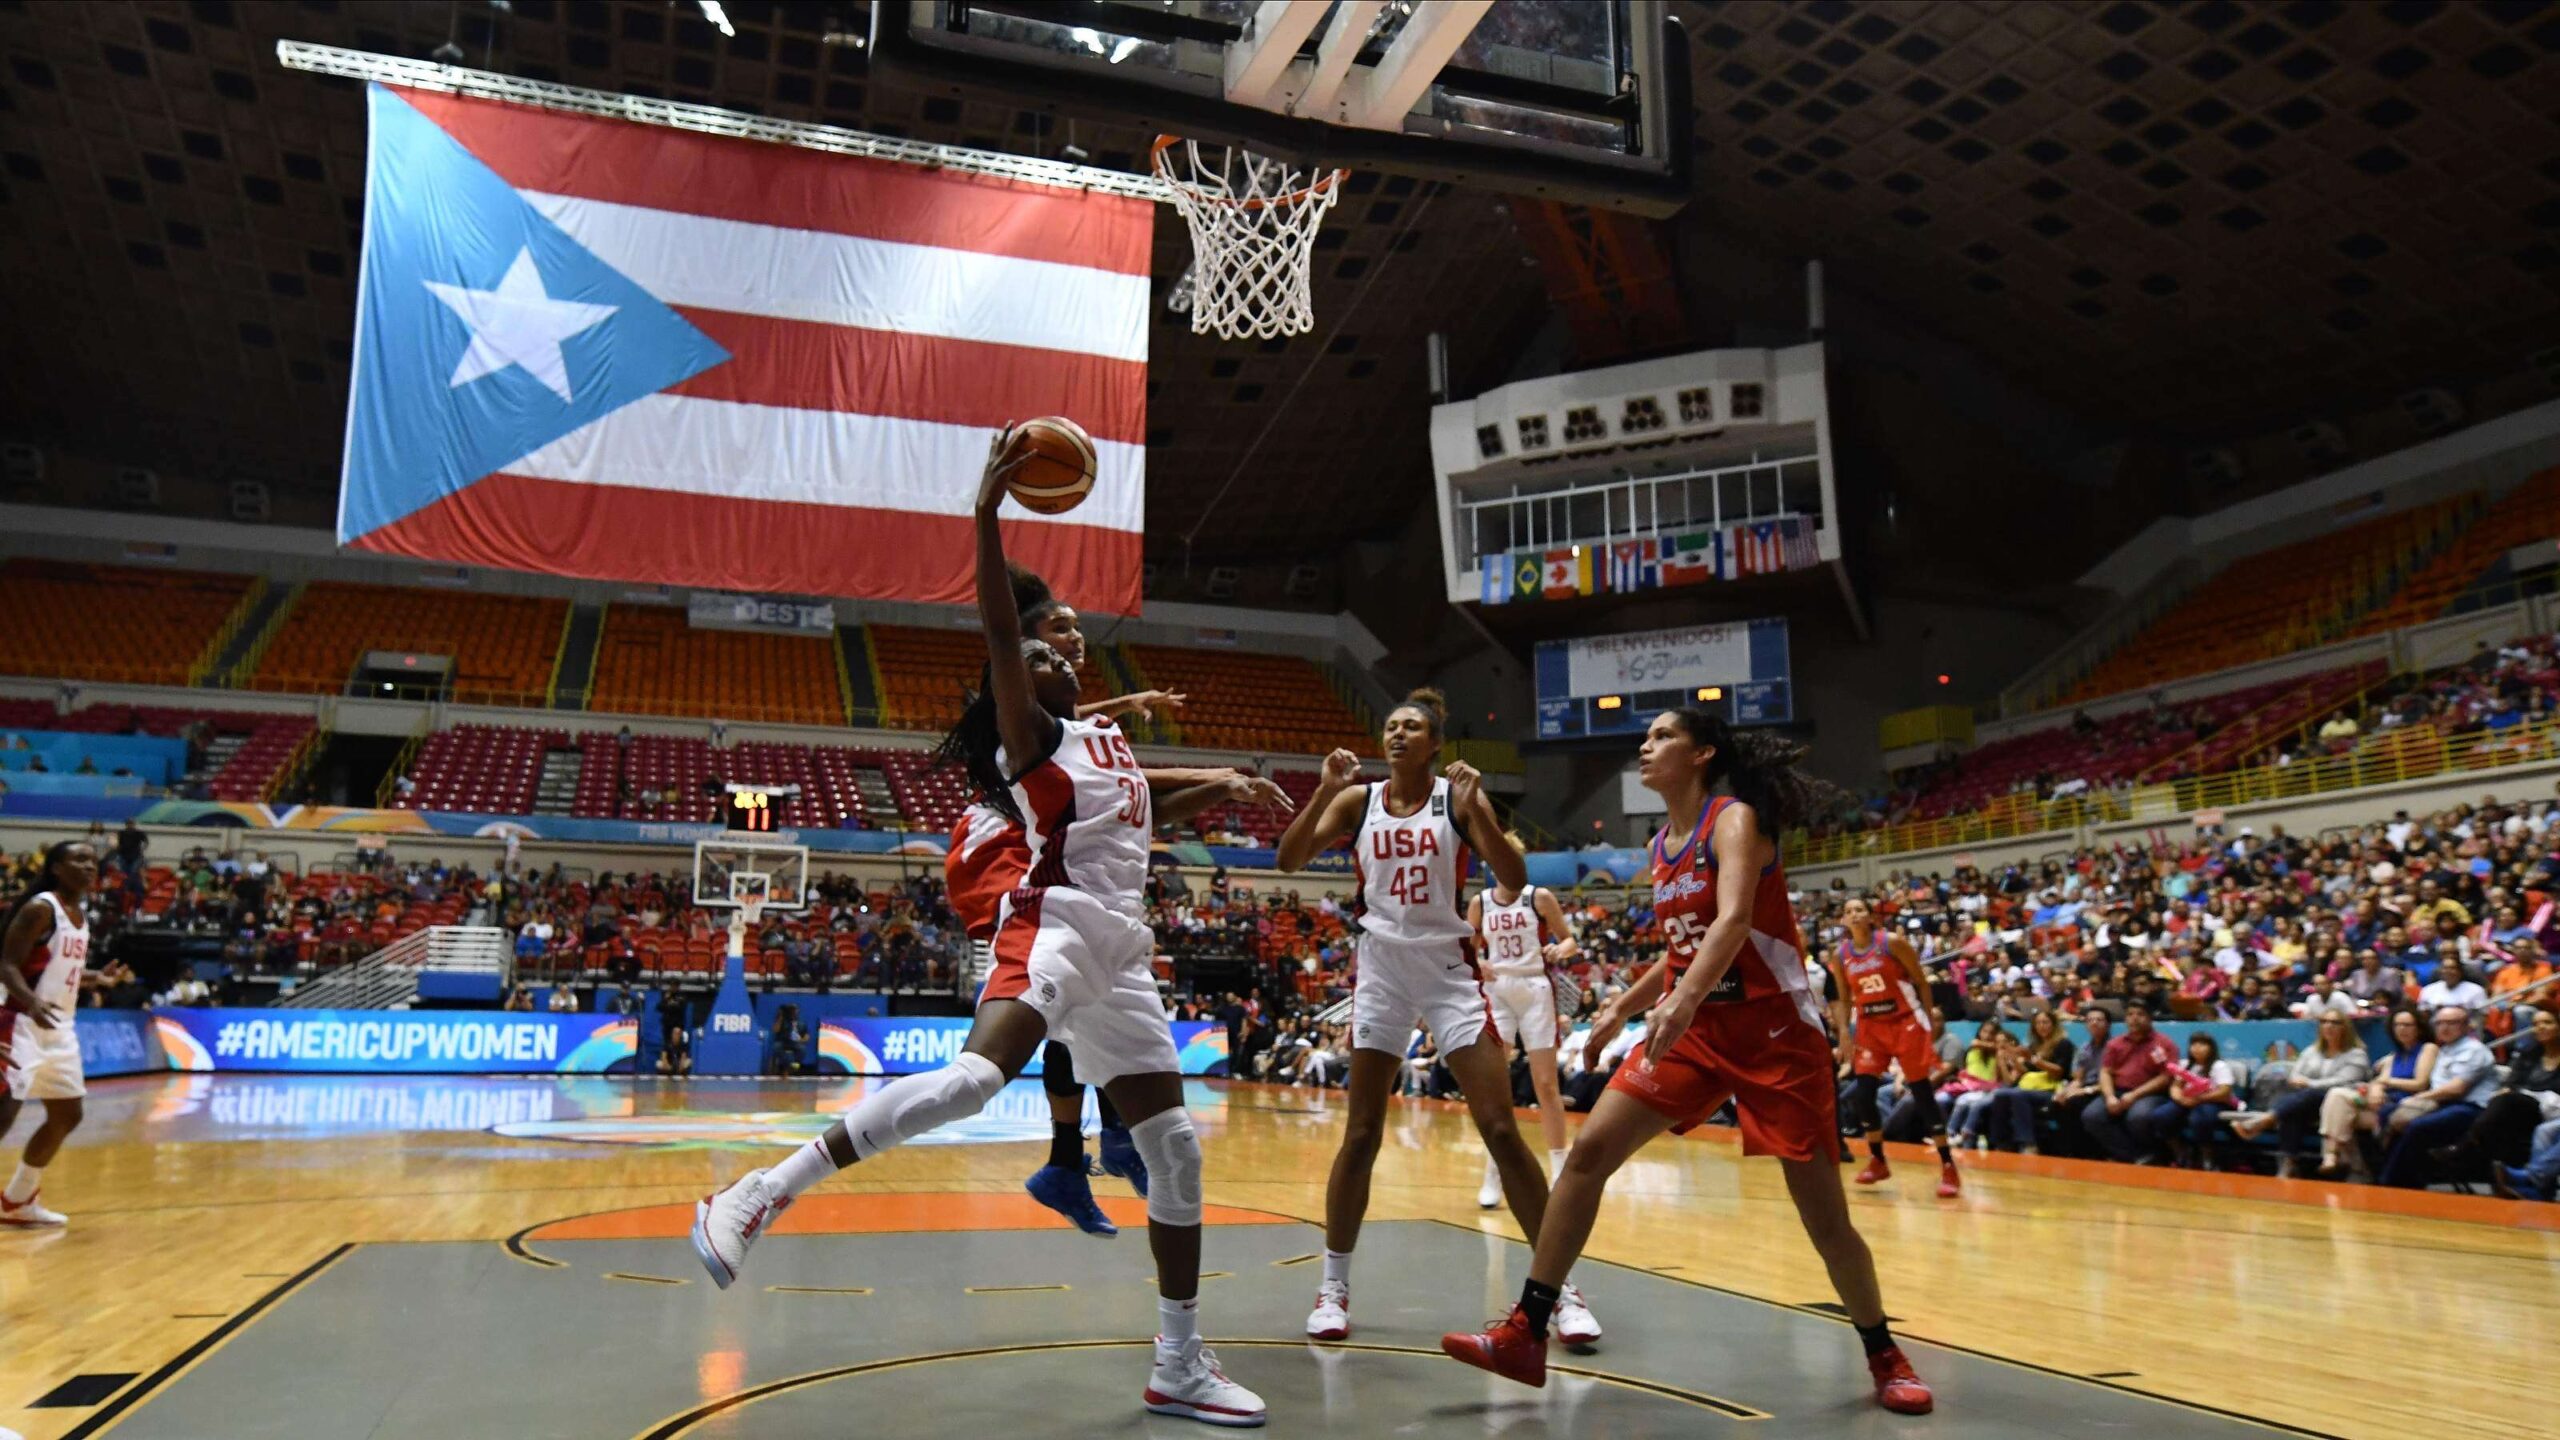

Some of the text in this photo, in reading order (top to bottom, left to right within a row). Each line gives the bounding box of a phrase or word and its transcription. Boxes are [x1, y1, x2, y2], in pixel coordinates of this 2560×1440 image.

[1083, 734, 1139, 770] US
[748, 807, 770, 831] 11
[1117, 776, 1148, 829] 30
[1373, 827, 1440, 860] USA
[1390, 864, 1430, 906] 42
[1488, 911, 1528, 932] USA
[1664, 911, 1709, 955] 25
[1498, 934, 1524, 959] 33
[215, 1019, 558, 1061] #AMERICUPWOMEN
[713, 1013, 751, 1033] FIBA
